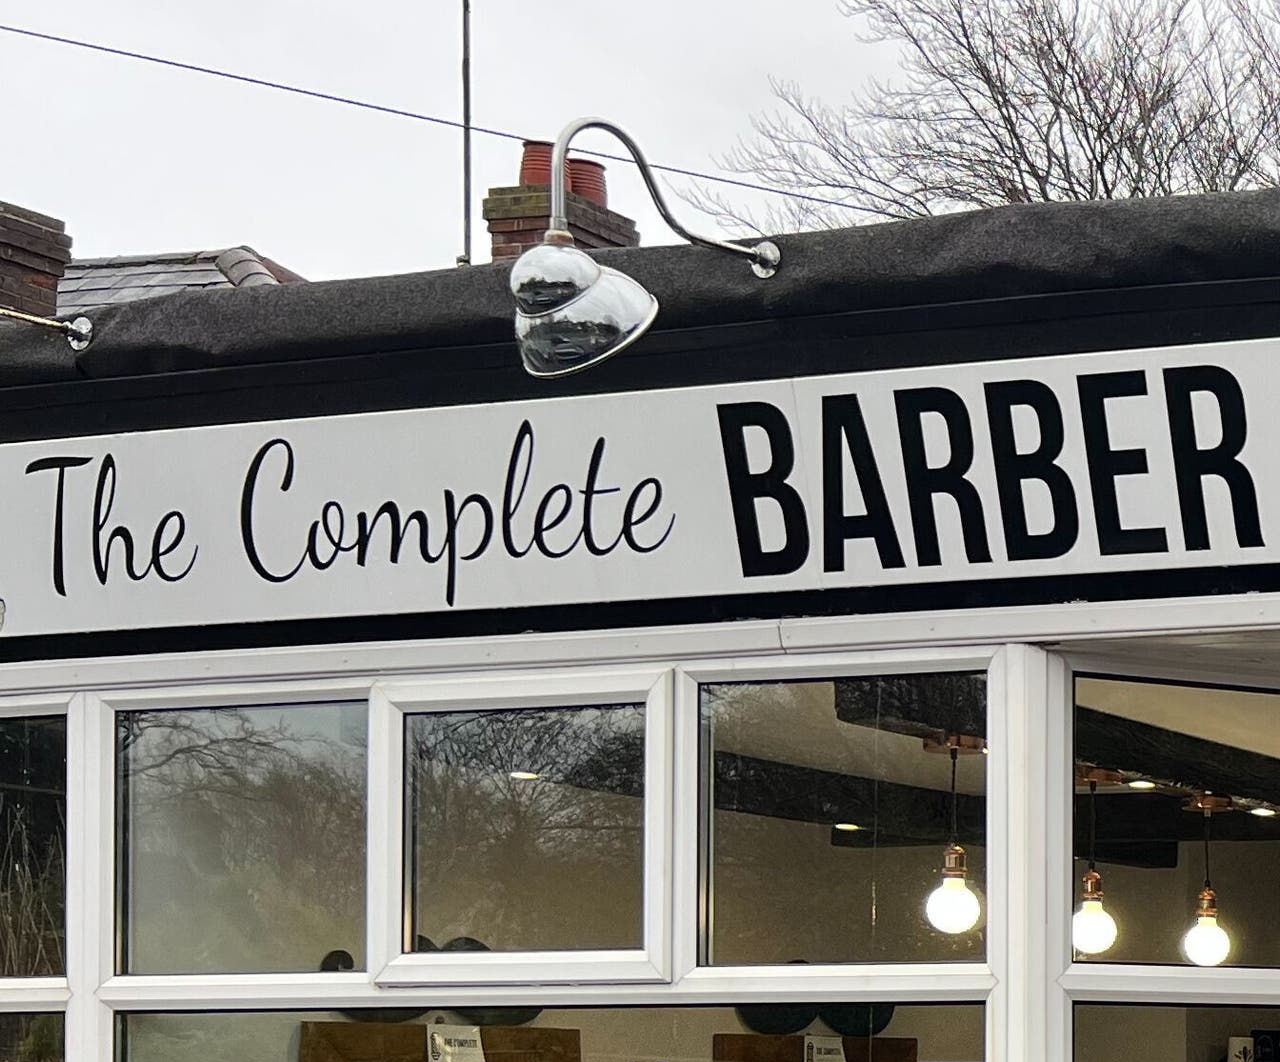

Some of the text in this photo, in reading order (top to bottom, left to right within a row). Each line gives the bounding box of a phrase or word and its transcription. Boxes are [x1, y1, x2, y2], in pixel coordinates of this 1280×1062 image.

[25, 454, 198, 597] The
[240, 419, 676, 608] Complete
[718, 365, 1265, 579] BARBER
